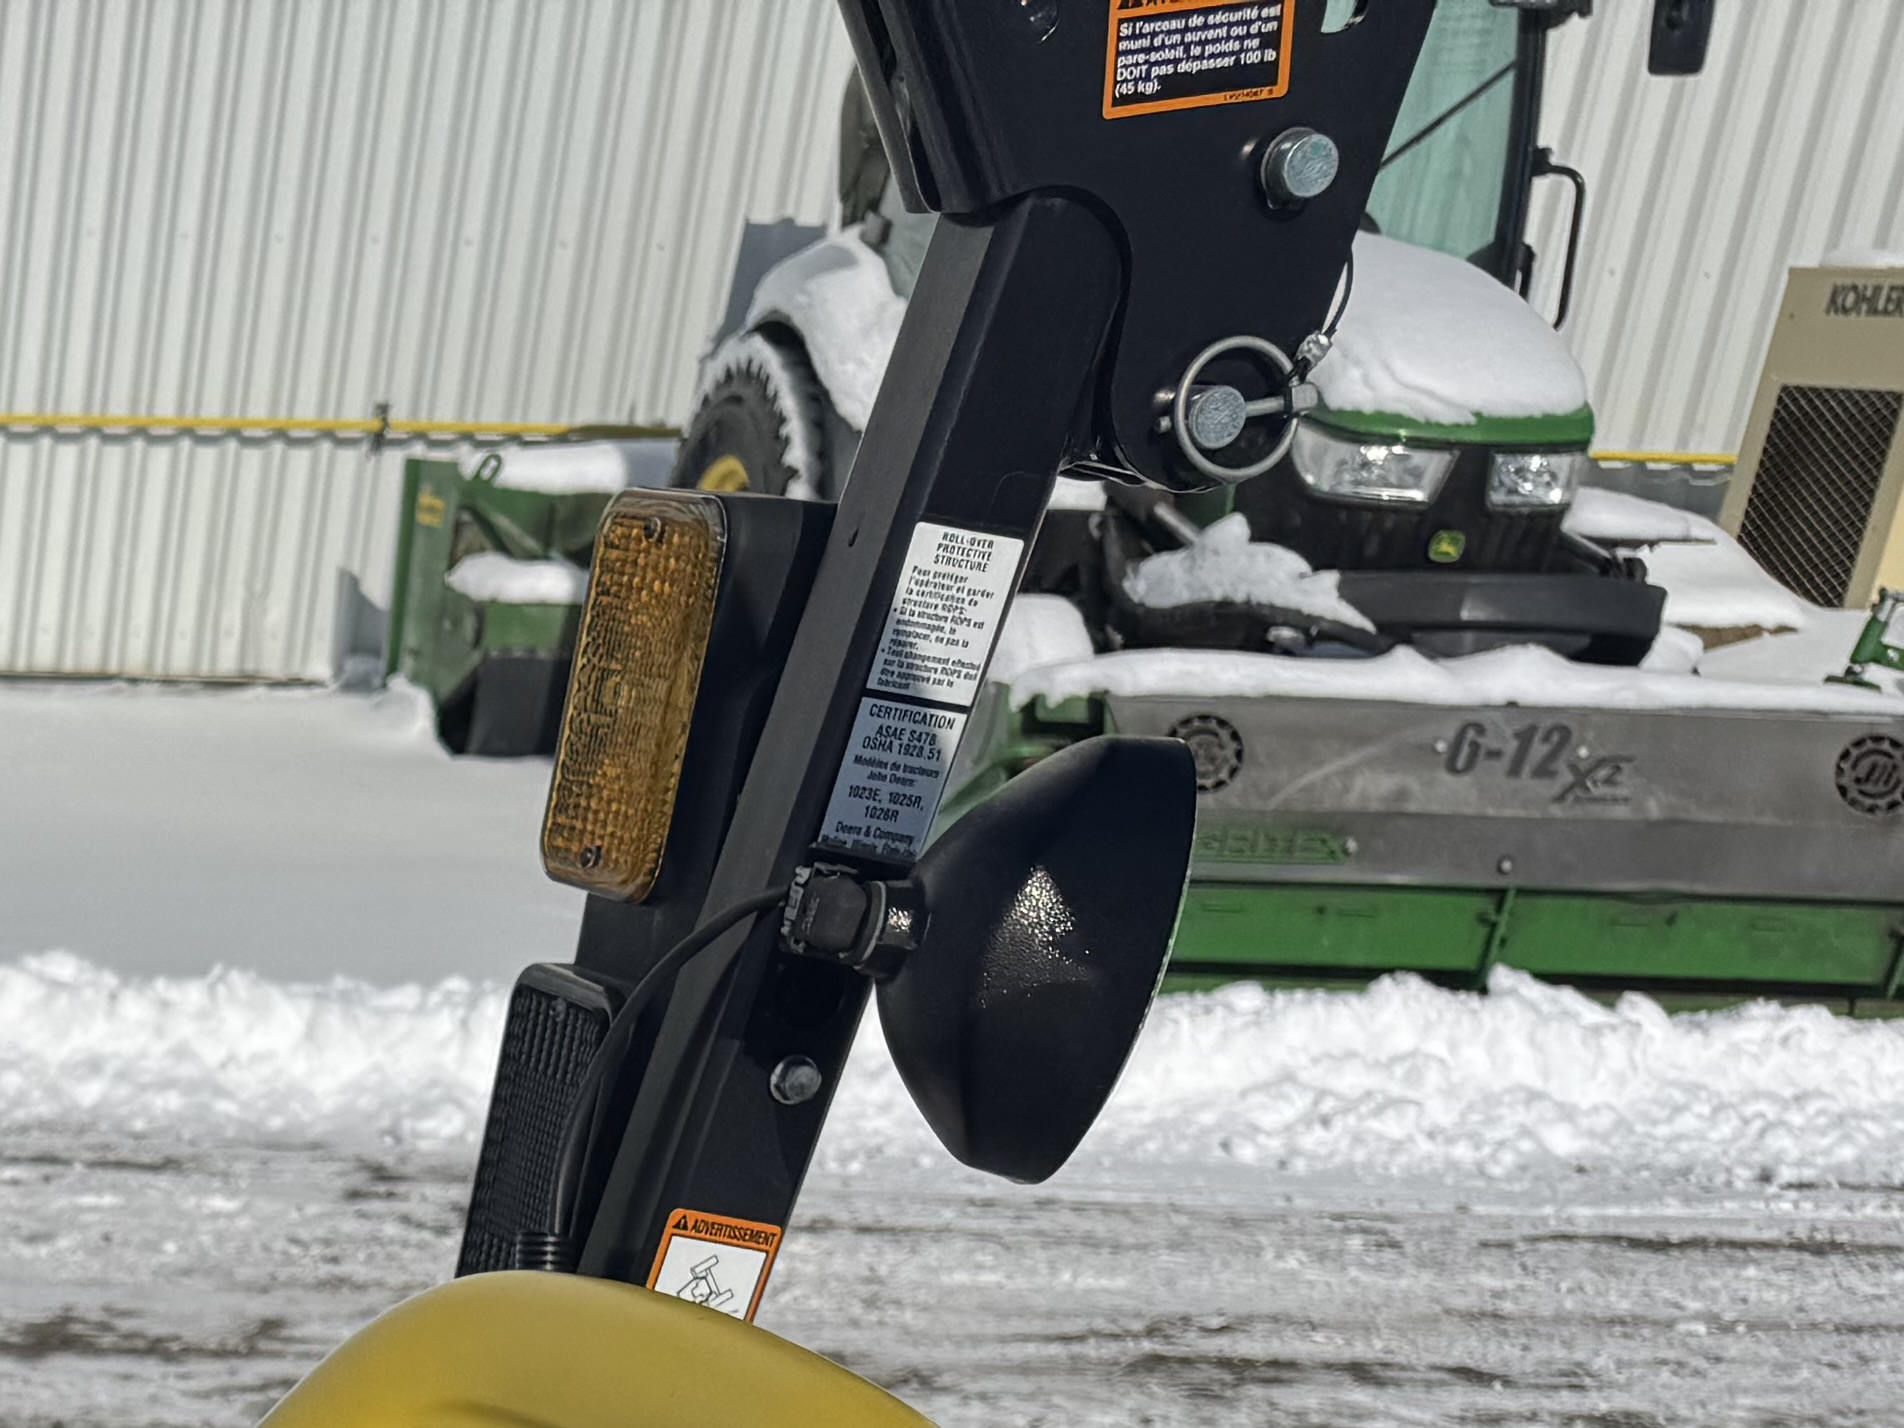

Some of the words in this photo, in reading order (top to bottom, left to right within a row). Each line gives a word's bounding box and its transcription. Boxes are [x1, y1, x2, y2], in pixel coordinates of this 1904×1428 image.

[1119, 23, 1132, 37] Si
[1188, 15, 1204, 27] de
[1208, 7, 1259, 25] sécurité
[1261, 4, 1281, 17] est
[1119, 36, 1150, 51] muni
[1154, 33, 1181, 47] d'un
[1185, 26, 1227, 42] auvent
[1231, 25, 1246, 36] ou
[1249, 21, 1278, 33] d'un
[1190, 45, 1201, 57] le
[1205, 40, 1240, 56] poids
[1244, 38, 1260, 49] ne
[1117, 66, 1148, 80] DOIT
[1151, 64, 1174, 78] pas
[1177, 54, 1235, 74] dépasser
[1240, 51, 1261, 65] 100
[1265, 49, 1276, 62] lb
[1115, 82, 1134, 98] (45
[1137, 80, 1161, 94] kg).
[936, 543, 992, 561] PROTECTIVE
[934, 554, 989, 572] STRUCTURE
[869, 703, 956, 730] CERTIFICATION
[875, 724, 905, 741] ASAE
[909, 730, 937, 745] S478
[862, 736, 893, 752] OSHA
[897, 742, 941, 761] 1928.51
[1444, 721, 1573, 779] 6-12
[867, 771, 887, 785] John
[848, 784, 882, 804] 1023E,
[864, 806, 899, 823] 1026R
[835, 821, 862, 837] Deere
[864, 826, 872, 838] &
[873, 826, 914, 845] Company
